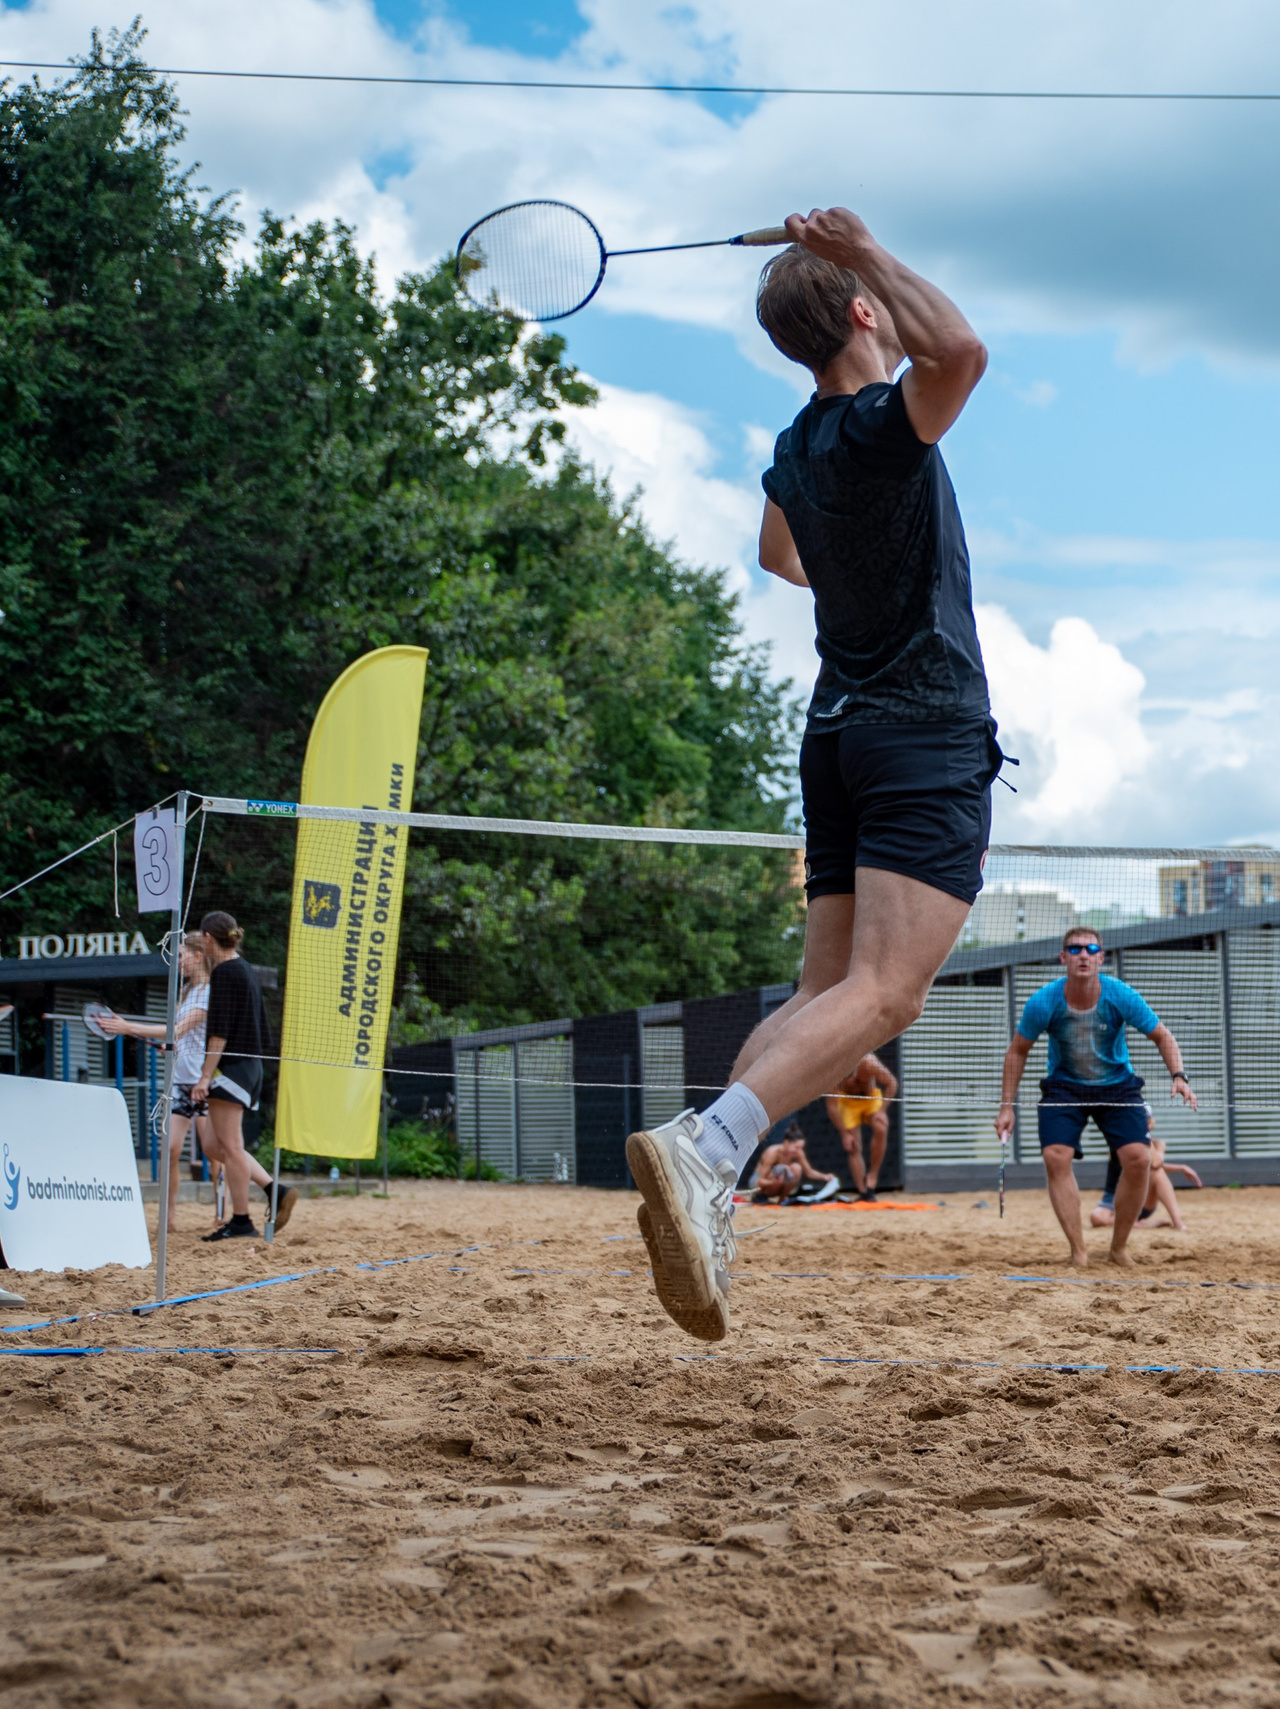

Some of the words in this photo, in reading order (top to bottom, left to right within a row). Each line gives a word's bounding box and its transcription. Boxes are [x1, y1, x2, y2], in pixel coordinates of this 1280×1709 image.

[265, 803, 295, 815] YONEX
[142, 826, 171, 896] 3
[339, 805, 378, 1018] АДМИНИСТРАЦИ
[354, 930, 386, 1066] ГОРОДСКОГО
[373, 845, 396, 924] ОКРУГА
[385, 763, 404, 838] ХМКИ
[18, 931, 151, 960] ПОЛЯНА
[721, 1125, 739, 1151] FORZA
[27, 1176, 134, 1202] badmintonist.com
